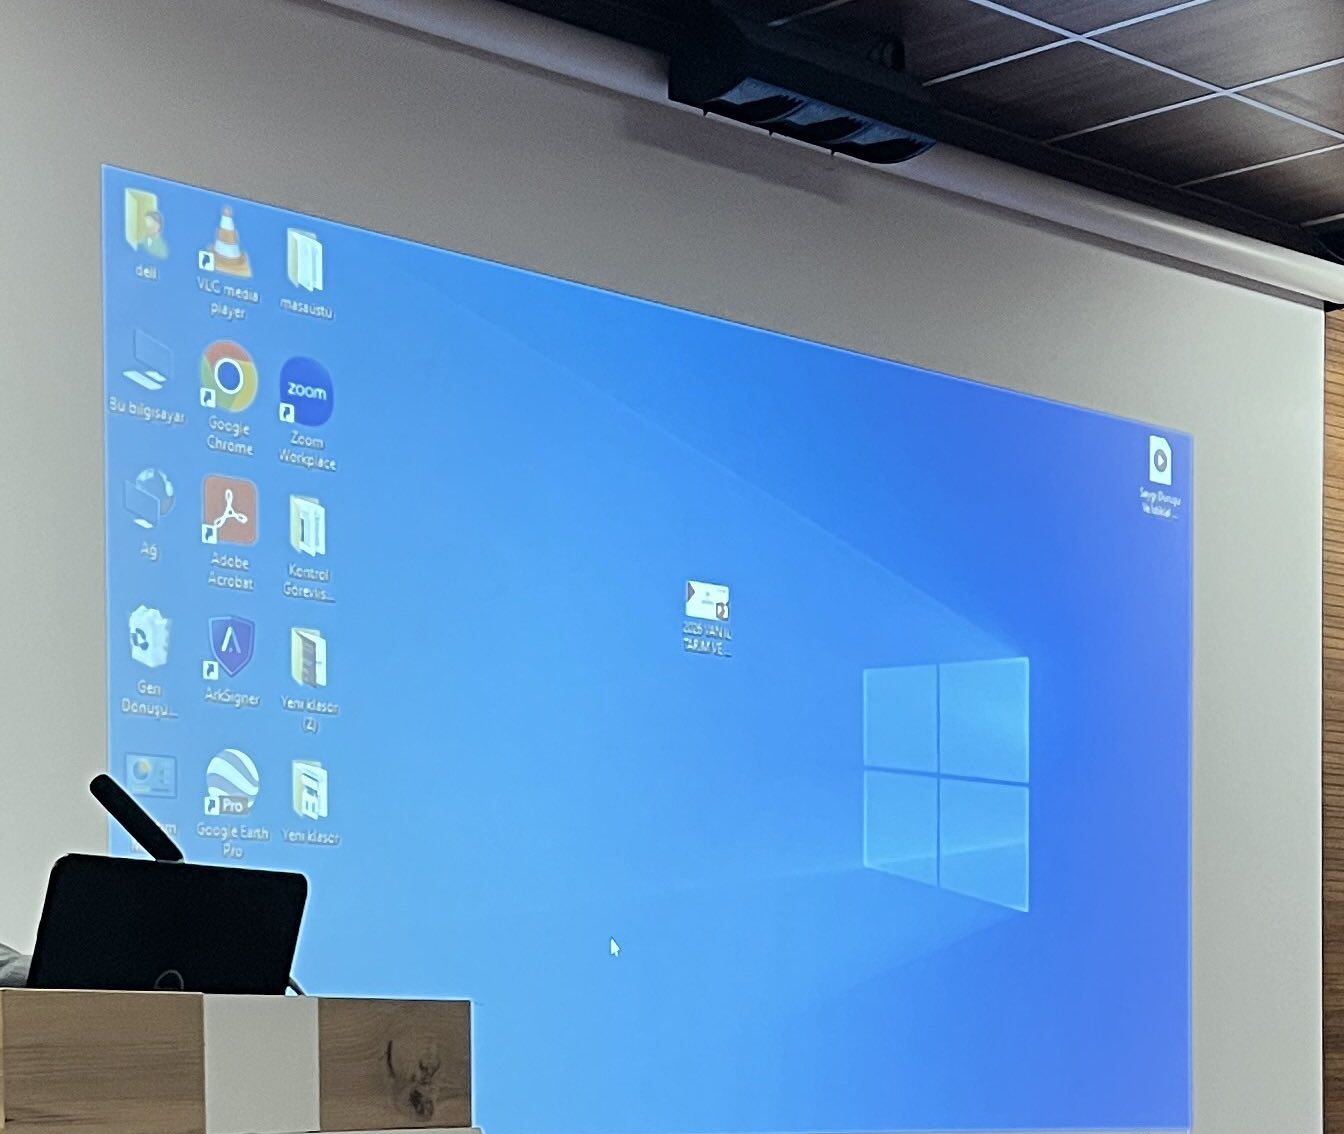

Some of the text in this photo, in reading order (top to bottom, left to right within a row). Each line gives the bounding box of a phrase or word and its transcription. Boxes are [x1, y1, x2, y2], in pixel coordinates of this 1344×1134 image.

[196, 276, 259, 303] VLC media
[211, 303, 246, 321] player
[288, 381, 327, 401] zoom
[109, 396, 126, 412] Bu
[208, 415, 251, 437] Google
[207, 435, 255, 456] Chrome
[290, 430, 325, 449] Zoom
[279, 448, 337, 472] Workplace
[211, 552, 249, 571] Adobe
[208, 571, 255, 592] Acrobat
[289, 563, 329, 581] Kontrol
[222, 798, 244, 812] Pro
[196, 822, 239, 840] Google
[240, 824, 269, 840] Earth
[223, 842, 244, 857] Pro
